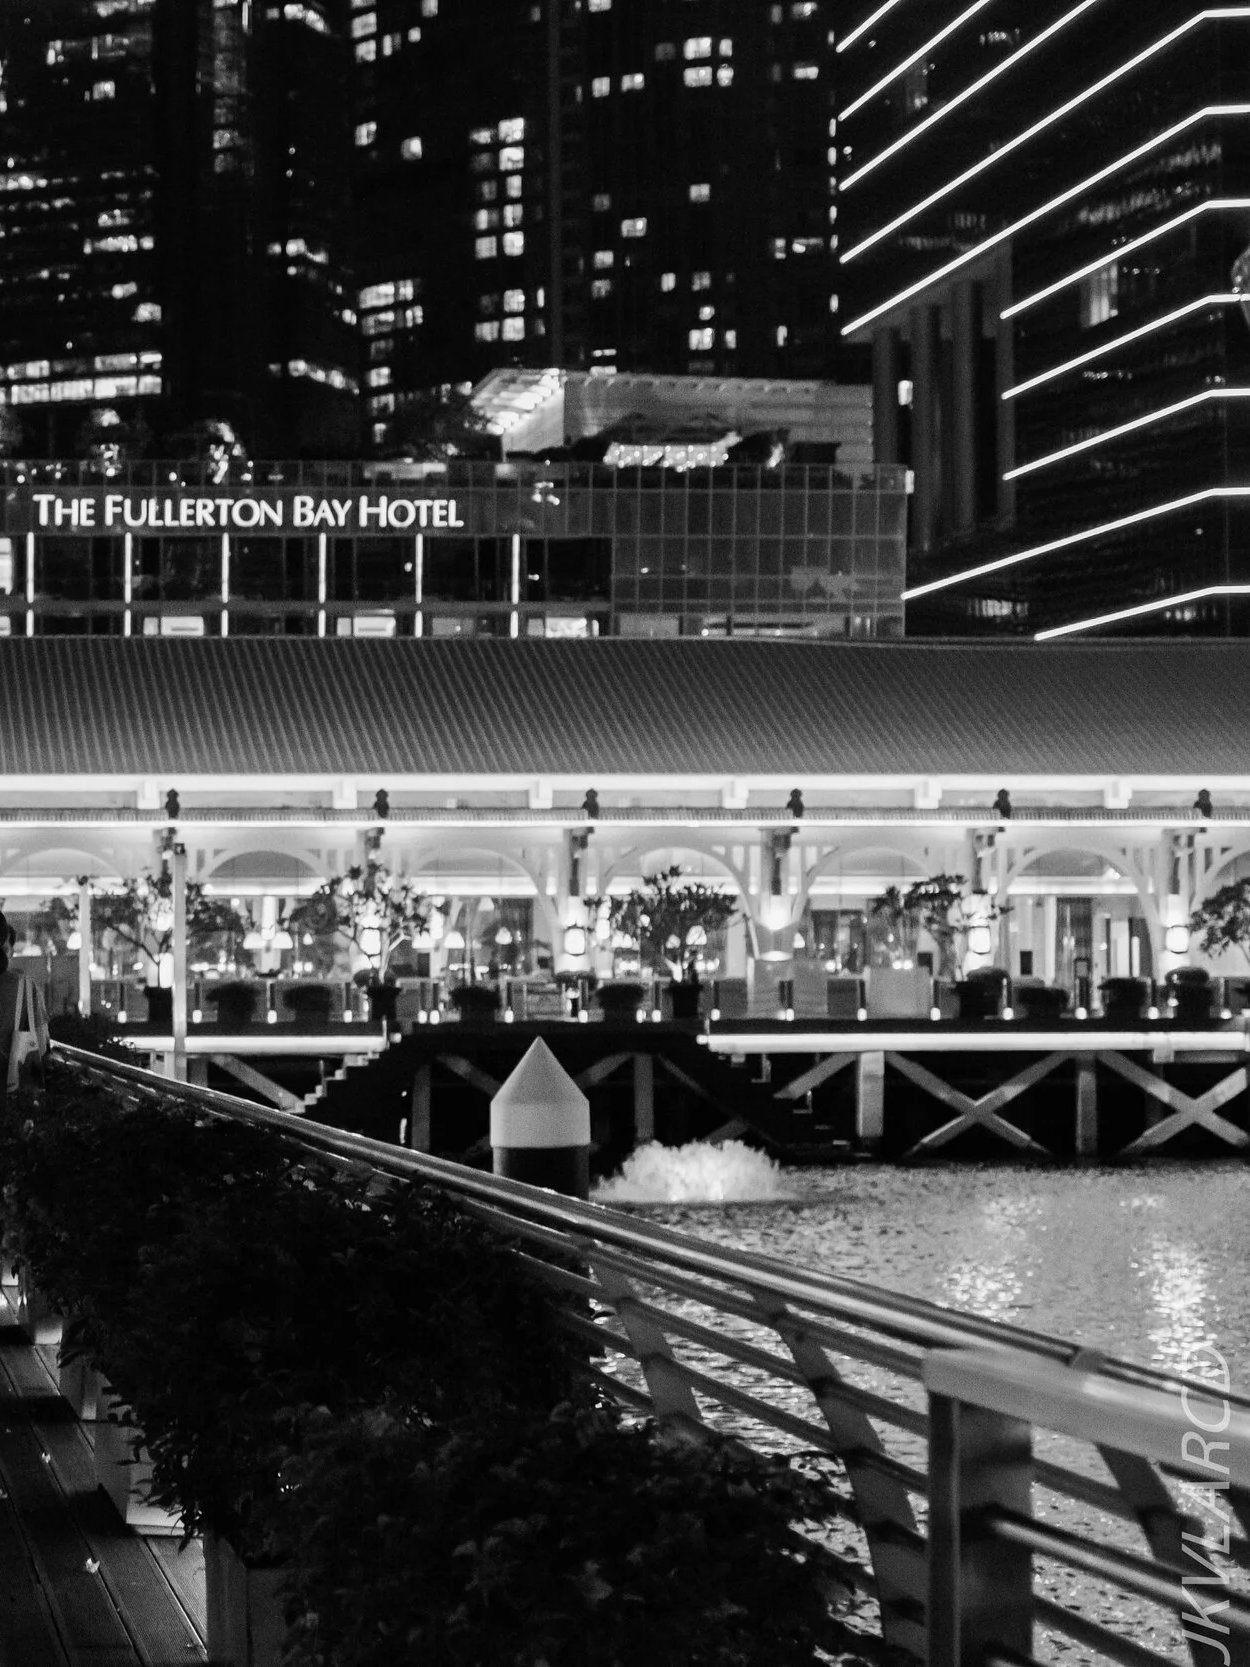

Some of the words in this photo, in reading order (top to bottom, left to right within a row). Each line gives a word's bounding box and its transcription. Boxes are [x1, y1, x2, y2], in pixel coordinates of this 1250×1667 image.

[33, 494, 95, 526] THE
[104, 495, 283, 527] FULLERTON
[292, 495, 351, 527] BAY
[359, 495, 464, 527] HOTEL
